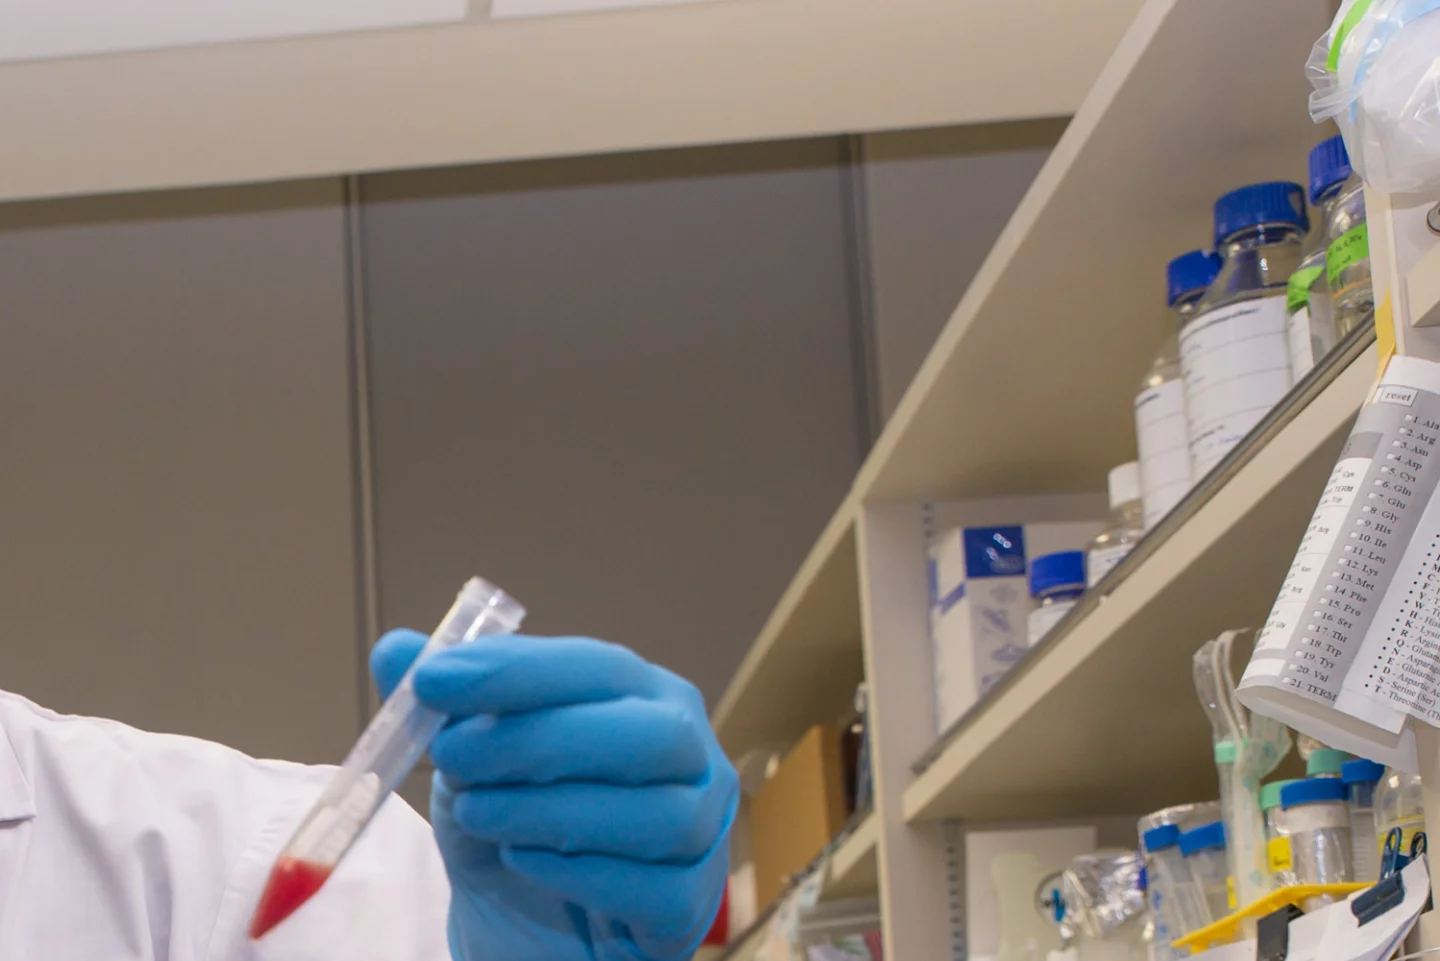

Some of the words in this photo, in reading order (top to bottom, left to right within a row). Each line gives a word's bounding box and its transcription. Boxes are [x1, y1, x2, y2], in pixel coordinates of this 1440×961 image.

[1385, 391, 1412, 402] reset
[1417, 433, 1436, 446] Arg
[1411, 446, 1429, 457] Asn
[1404, 459, 1422, 471] Asp
[1400, 471, 1416, 483] Cys
[1394, 484, 1412, 496] Gln
[1387, 498, 1406, 510] Glu
[1381, 510, 1399, 523] Gly
[1374, 523, 1392, 535] His
[1374, 537, 1387, 548] Ile
[1368, 551, 1386, 564] Leu
[1362, 564, 1379, 576] Lys
[1355, 577, 1375, 591] Met
[1349, 591, 1368, 603] Phe
[1343, 604, 1361, 617] Pro
[1337, 617, 1353, 629] Ser
[1332, 630, 1348, 643] Thr
[1326, 643, 1342, 658] Trp
[1319, 656, 1335, 669] Tyr
[1314, 670, 1329, 682] Val
[1307, 684, 1338, 702] TERM
[1391, 681, 1417, 696] Serine
[1417, 692, 1436, 708] (Ser)
[1389, 690, 1427, 714] Threonine
